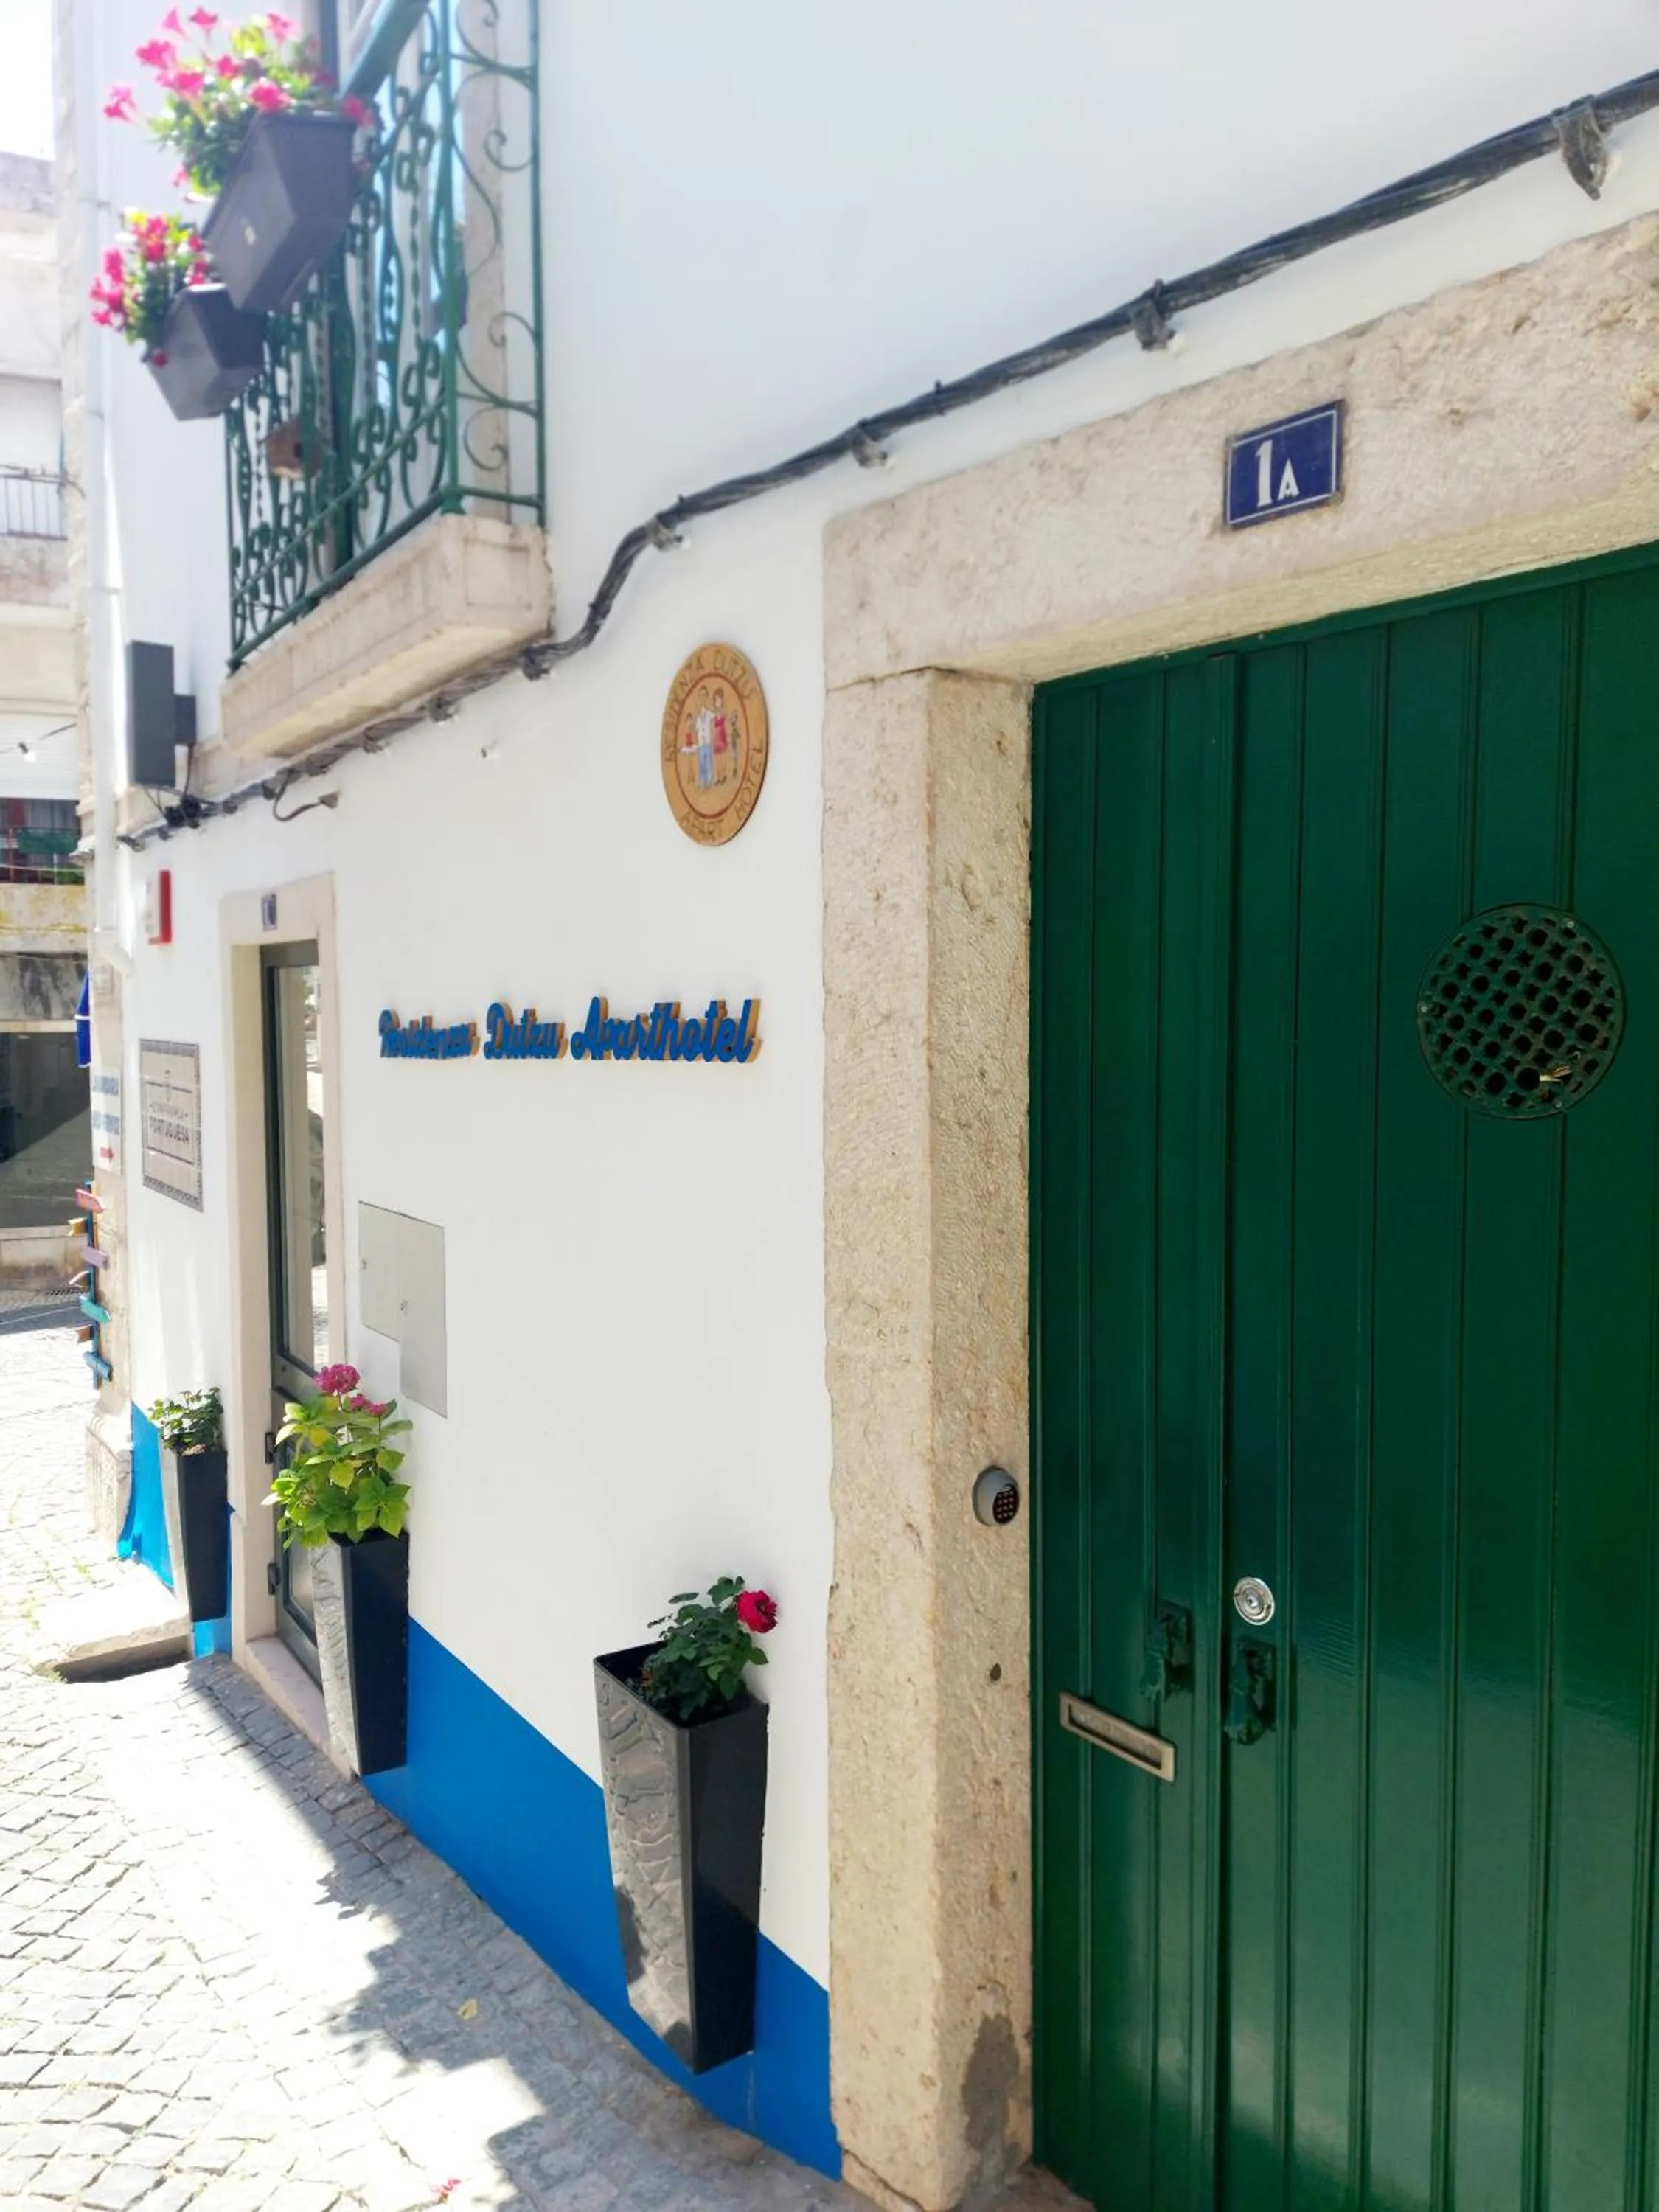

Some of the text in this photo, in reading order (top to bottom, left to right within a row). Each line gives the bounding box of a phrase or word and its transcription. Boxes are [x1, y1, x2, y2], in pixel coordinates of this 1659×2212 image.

[1255, 439, 1300, 508] 1A
[734, 737, 763, 821] HOTEL
[571, 996, 762, 1062] Aparthotel
